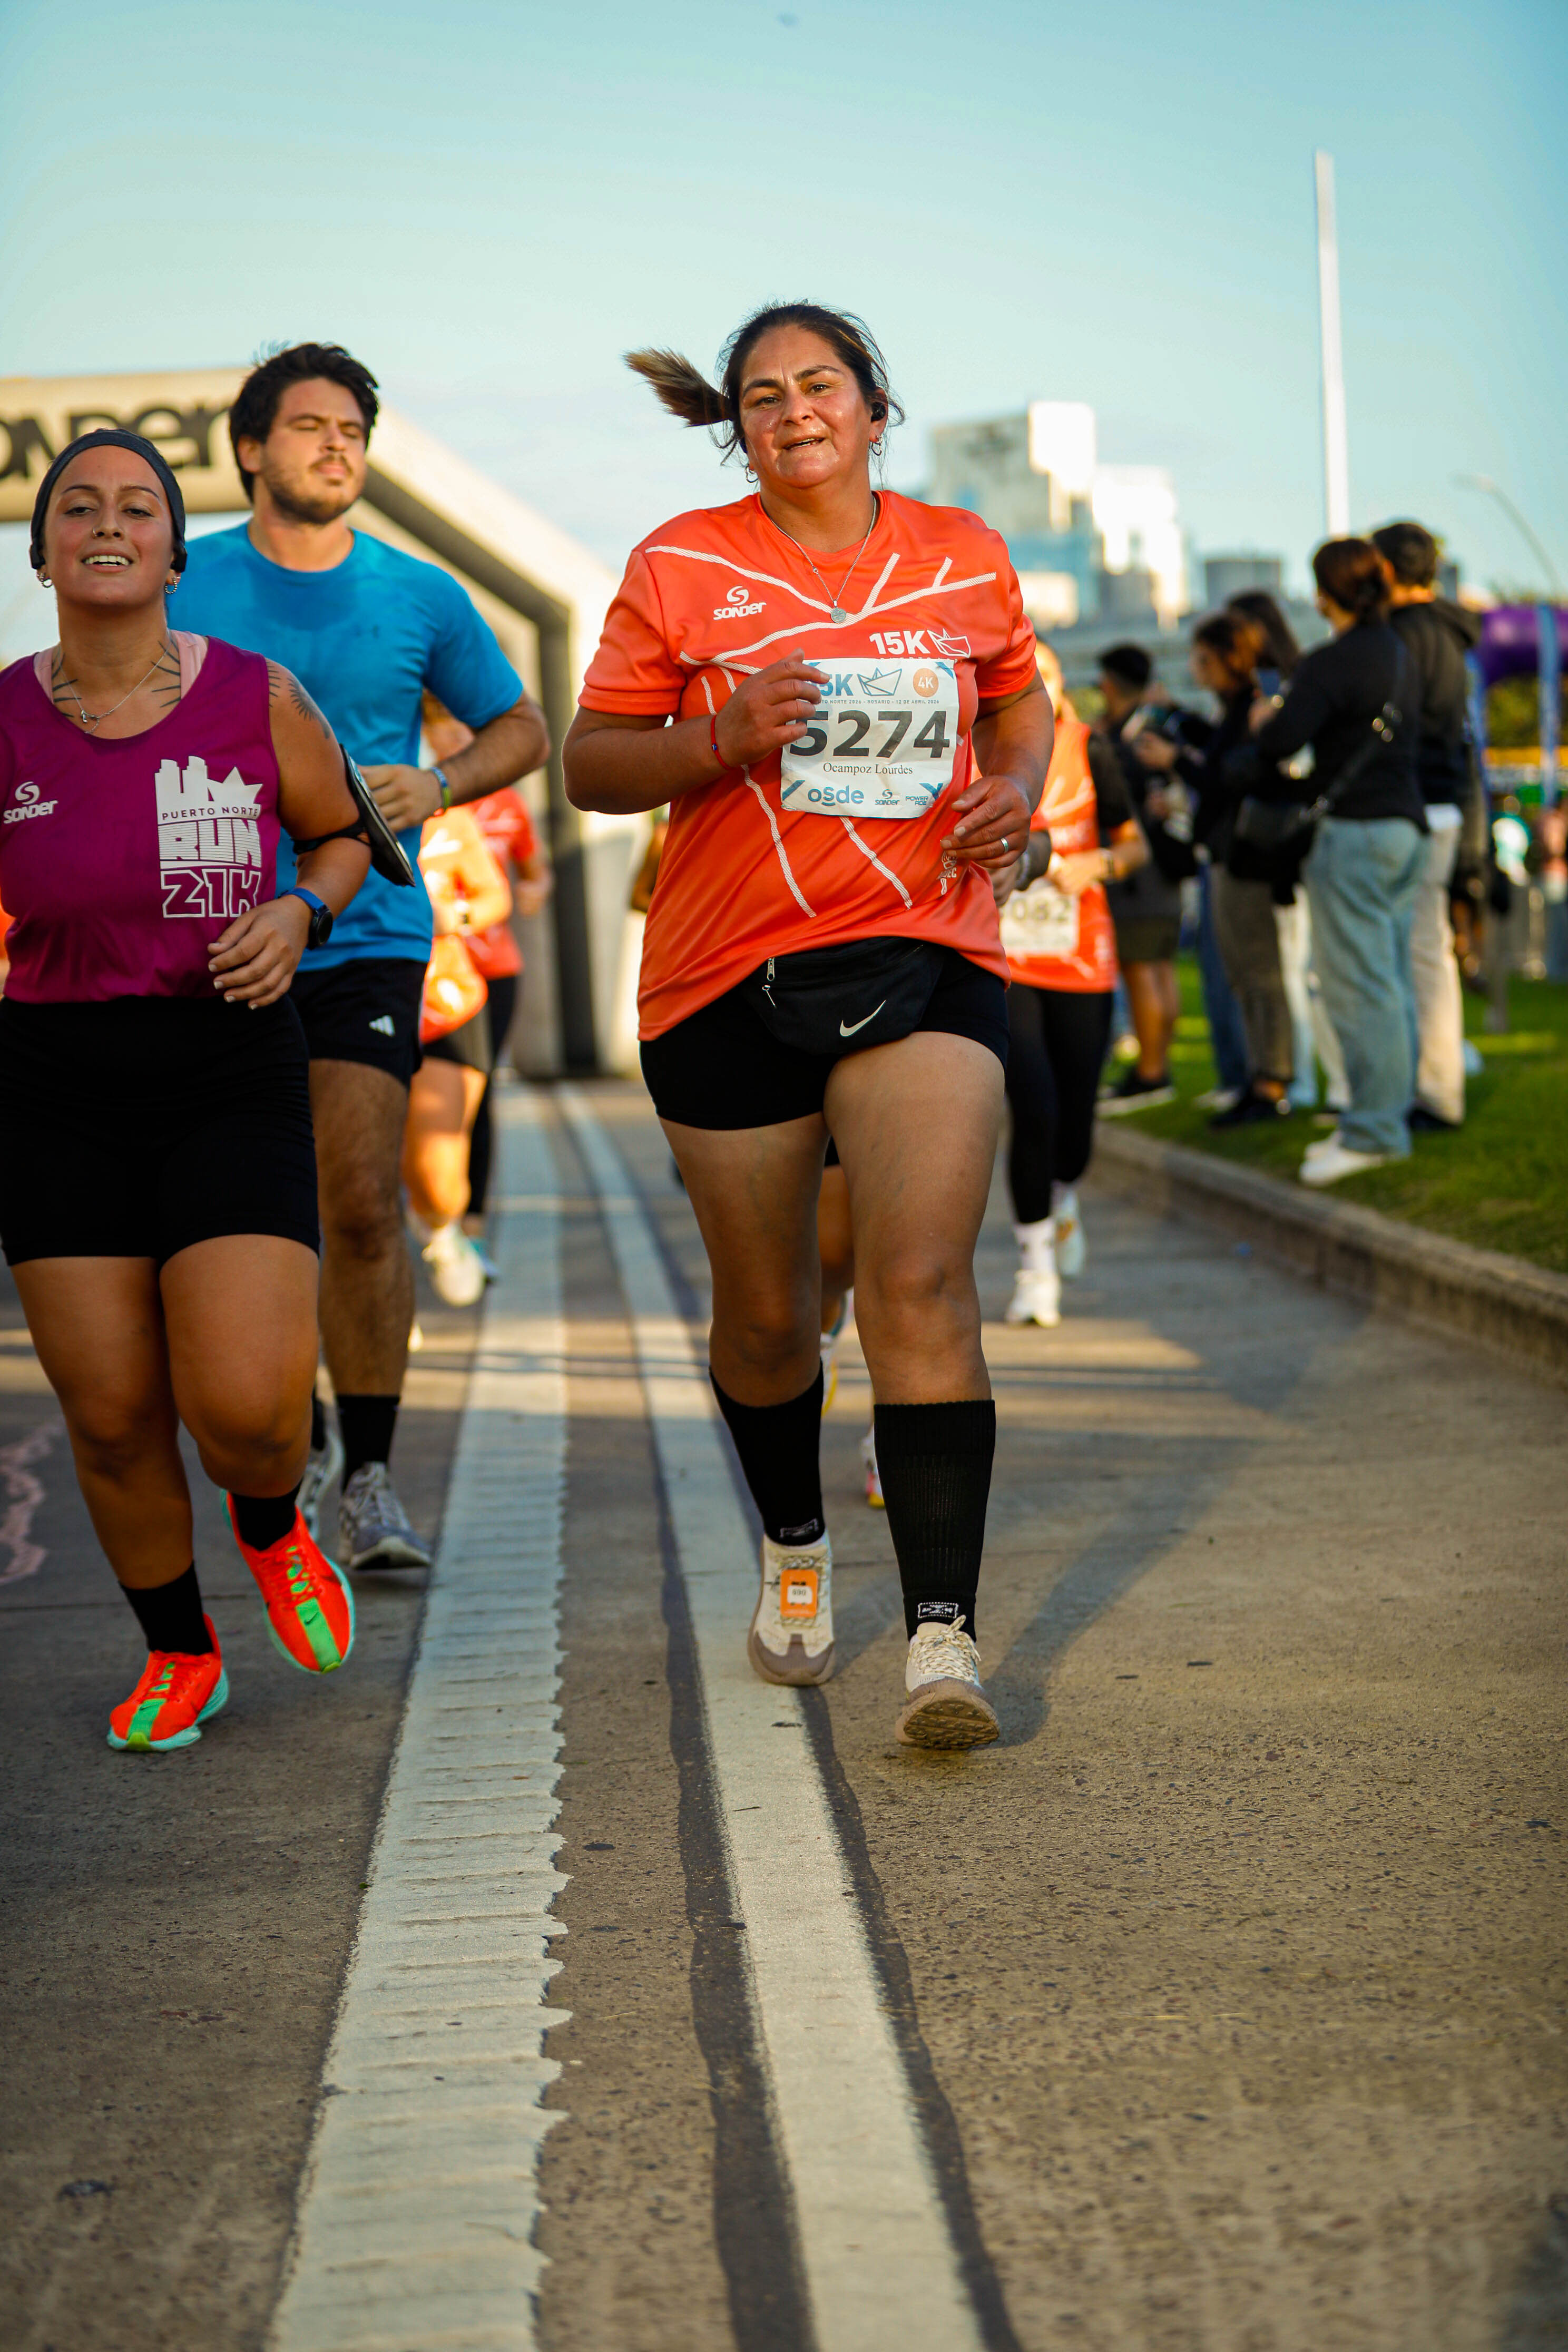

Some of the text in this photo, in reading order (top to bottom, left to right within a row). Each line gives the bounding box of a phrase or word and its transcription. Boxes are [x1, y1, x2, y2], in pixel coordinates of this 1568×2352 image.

[869, 631, 930, 654] 15K
[815, 674, 854, 696] 5K
[918, 676, 934, 689] 4K
[789, 710, 950, 758] 5274
[823, 762, 913, 775] Ocampoz Lourdes
[808, 785, 864, 805] osde
[162, 807, 258, 820] PUERTO NORTE
[158, 818, 262, 868] RUN
[160, 868, 262, 918] 21K
